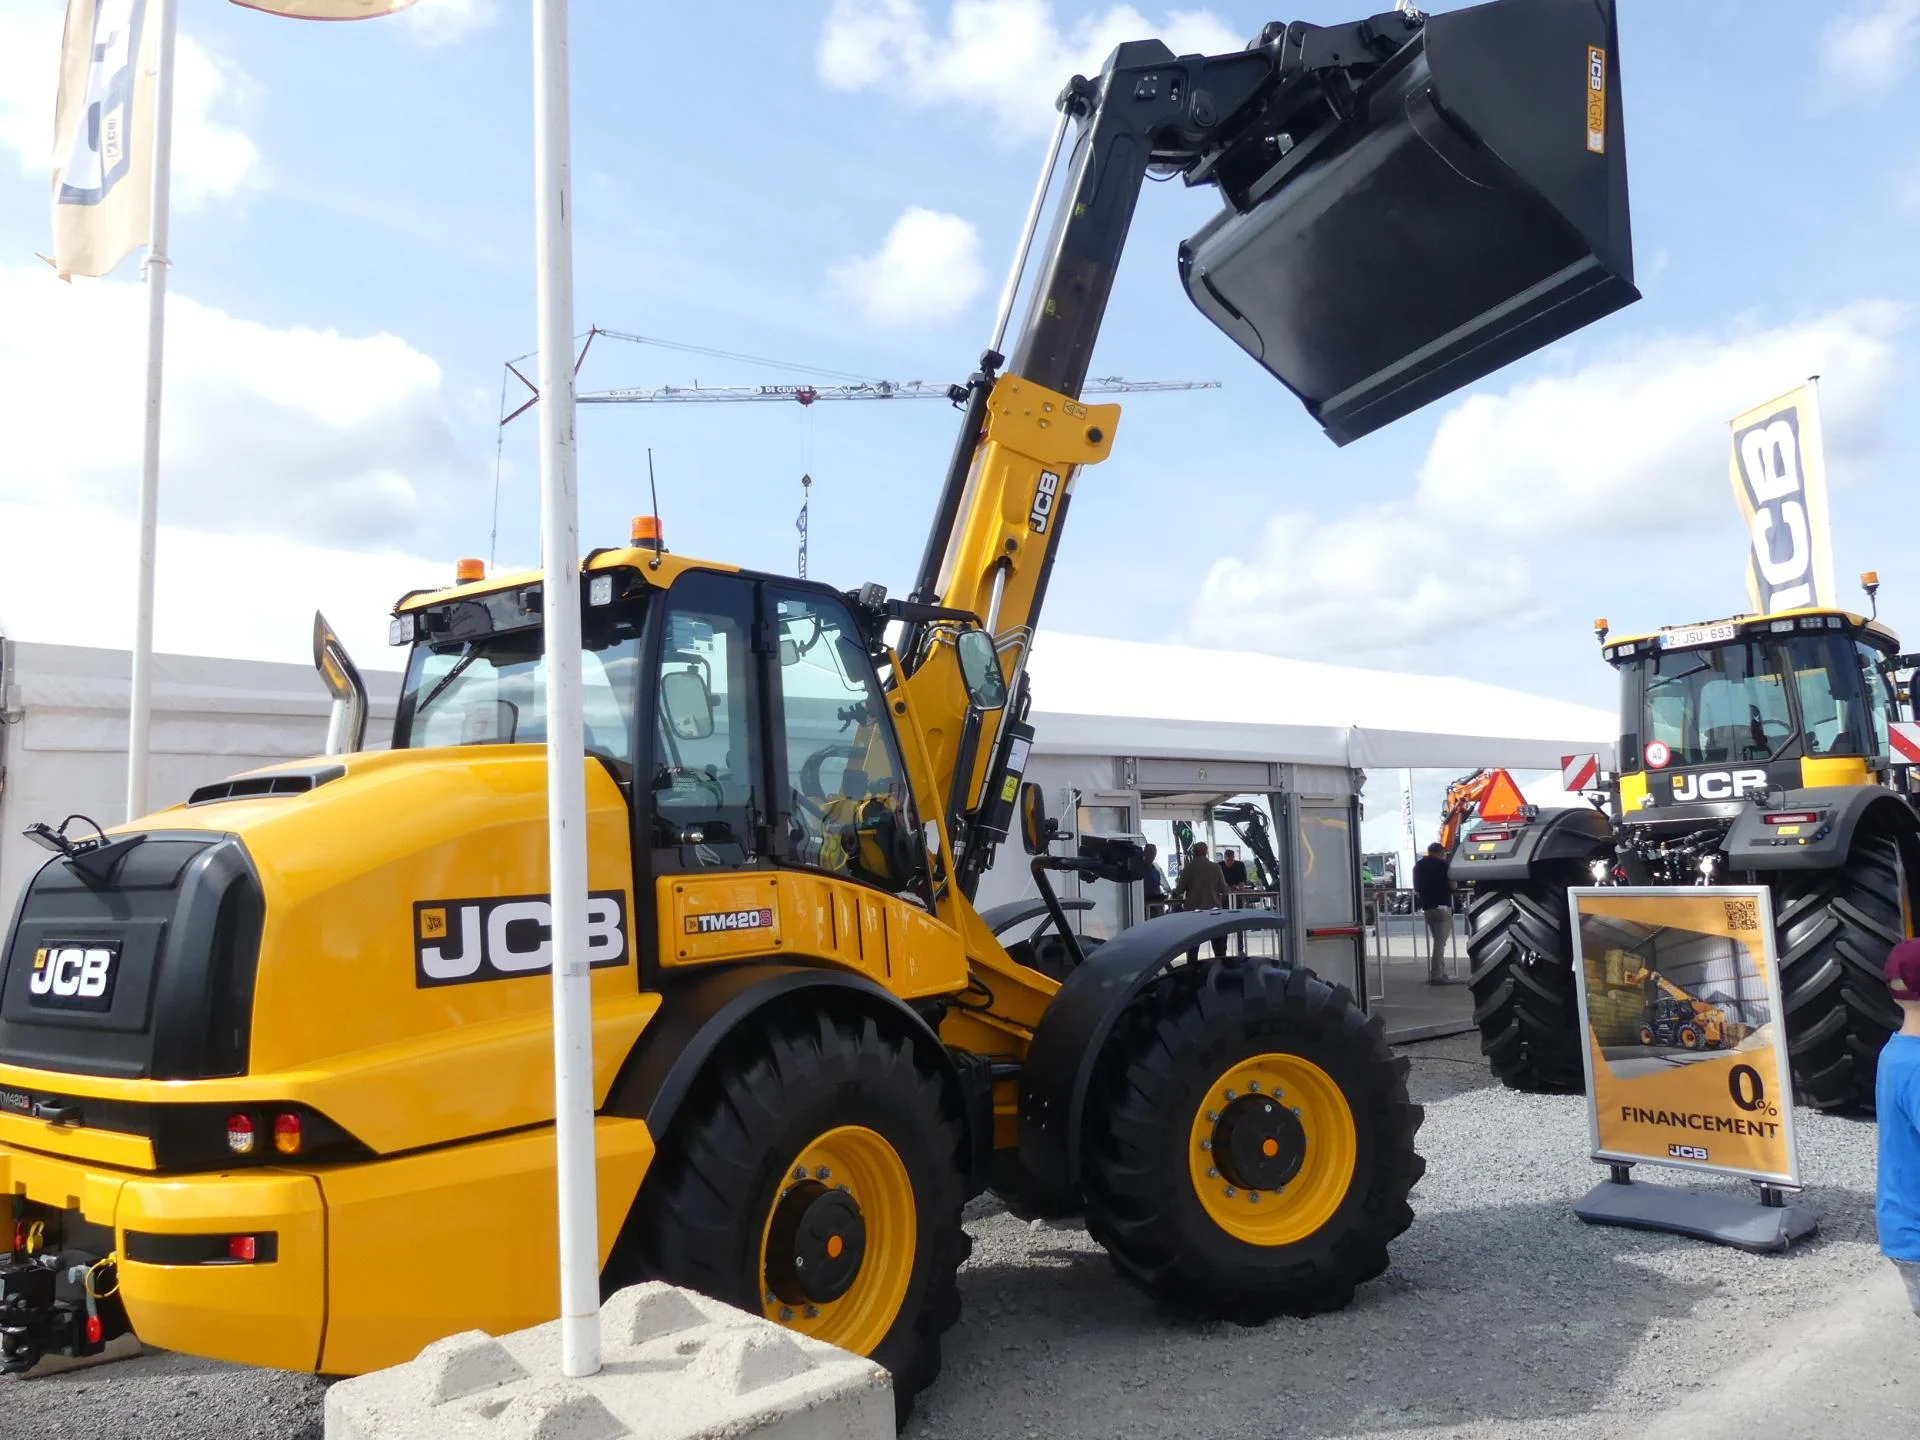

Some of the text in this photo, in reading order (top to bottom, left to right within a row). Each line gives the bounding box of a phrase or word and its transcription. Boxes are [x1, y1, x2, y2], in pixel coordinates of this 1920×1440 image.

[1589, 51, 1603, 134] JCB AGRI
[1030, 471, 1059, 533] JCB
[1652, 747, 1662, 760] 40
[422, 898, 624, 979] JCB
[699, 910, 772, 931] TM420S
[30, 949, 111, 997] JCB
[1621, 1106, 1779, 1138] FINANCEMENT
[1669, 1145, 1708, 1160] JCB
